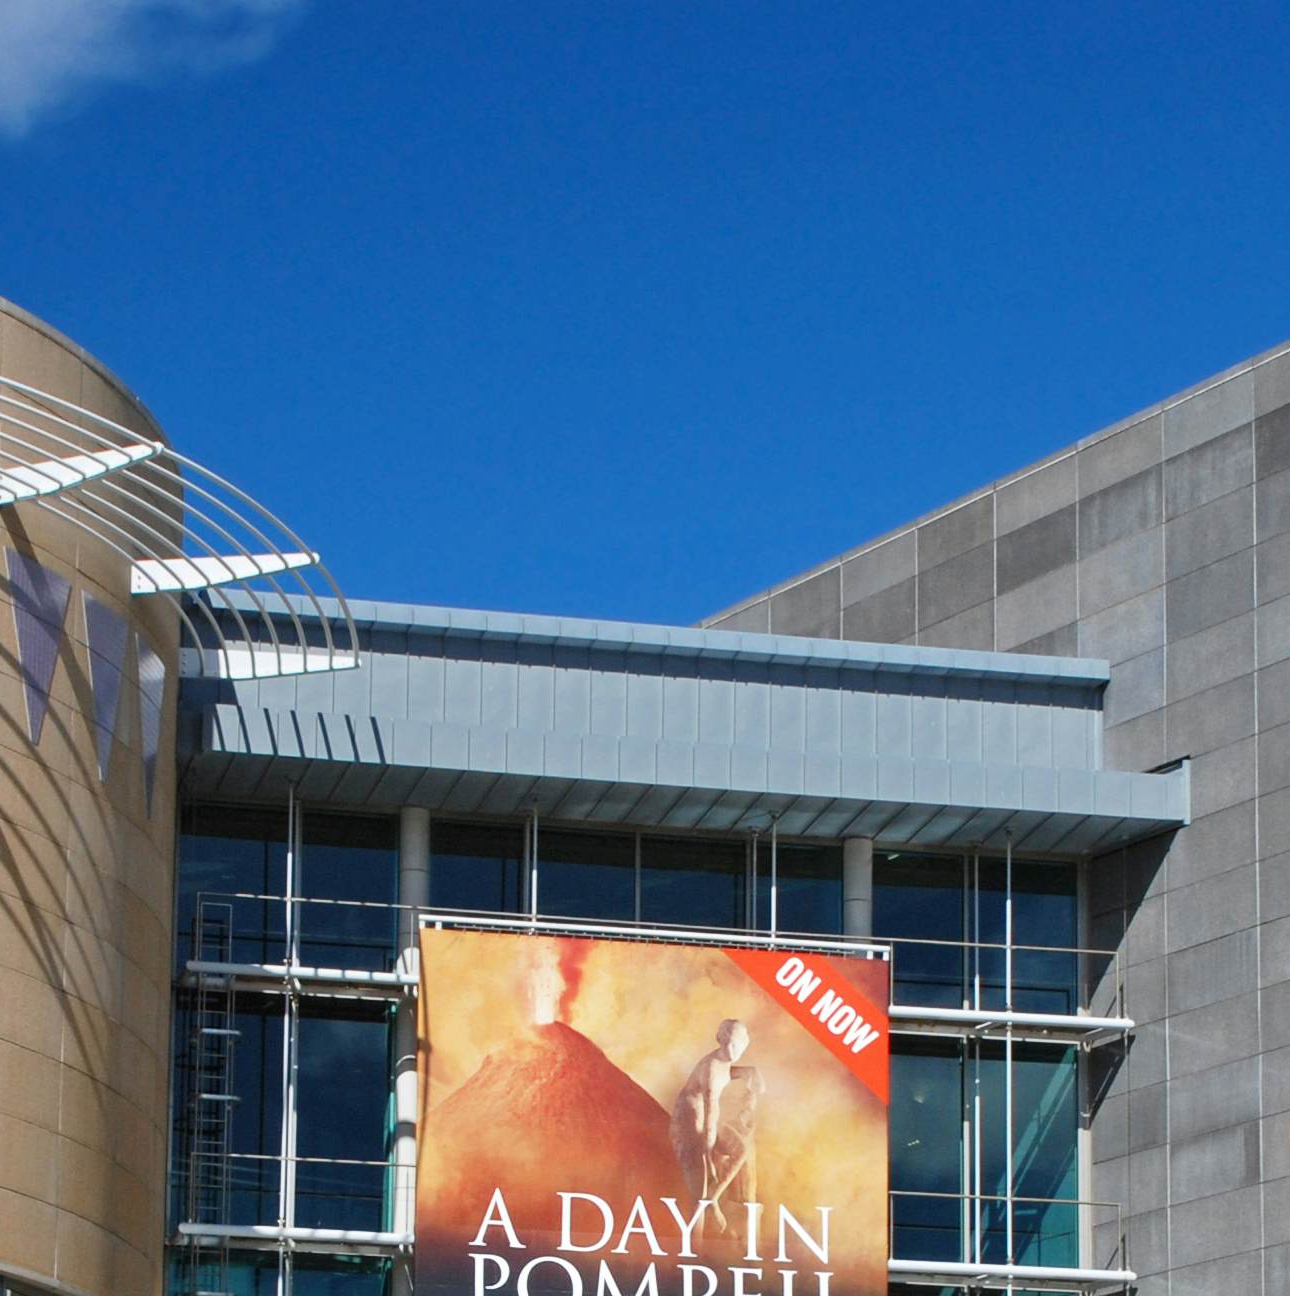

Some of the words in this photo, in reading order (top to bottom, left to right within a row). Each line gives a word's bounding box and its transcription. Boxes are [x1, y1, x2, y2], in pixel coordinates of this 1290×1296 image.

[775, 957, 822, 1004] ON
[810, 988, 880, 1054] NOW
[468, 1187, 527, 1249] A
[556, 1191, 713, 1258] DAY
[742, 1202, 834, 1265] IN
